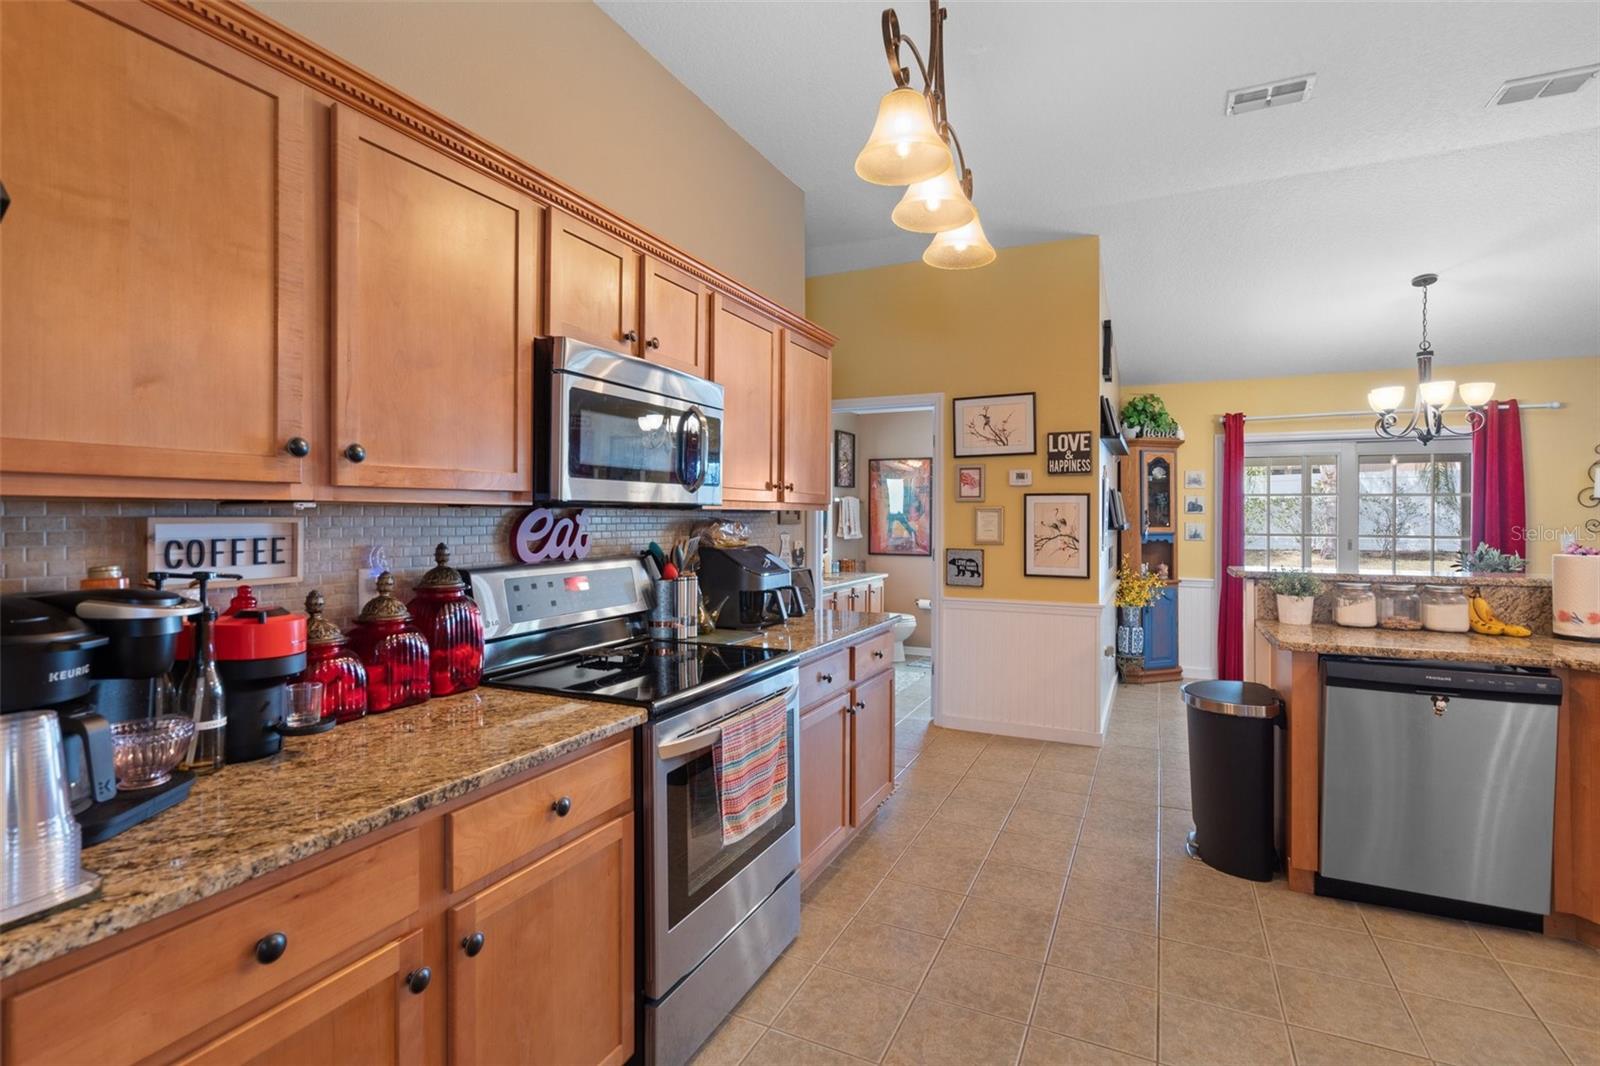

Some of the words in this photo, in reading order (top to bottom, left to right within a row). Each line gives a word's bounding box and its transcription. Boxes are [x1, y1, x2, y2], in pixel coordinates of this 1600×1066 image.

[1048, 433, 1090, 452] LOVE
[1064, 450, 1073, 460] &
[1049, 459, 1091, 473] HAPPINESS
[514, 507, 593, 564] eat
[164, 537, 286, 569] COFFEE
